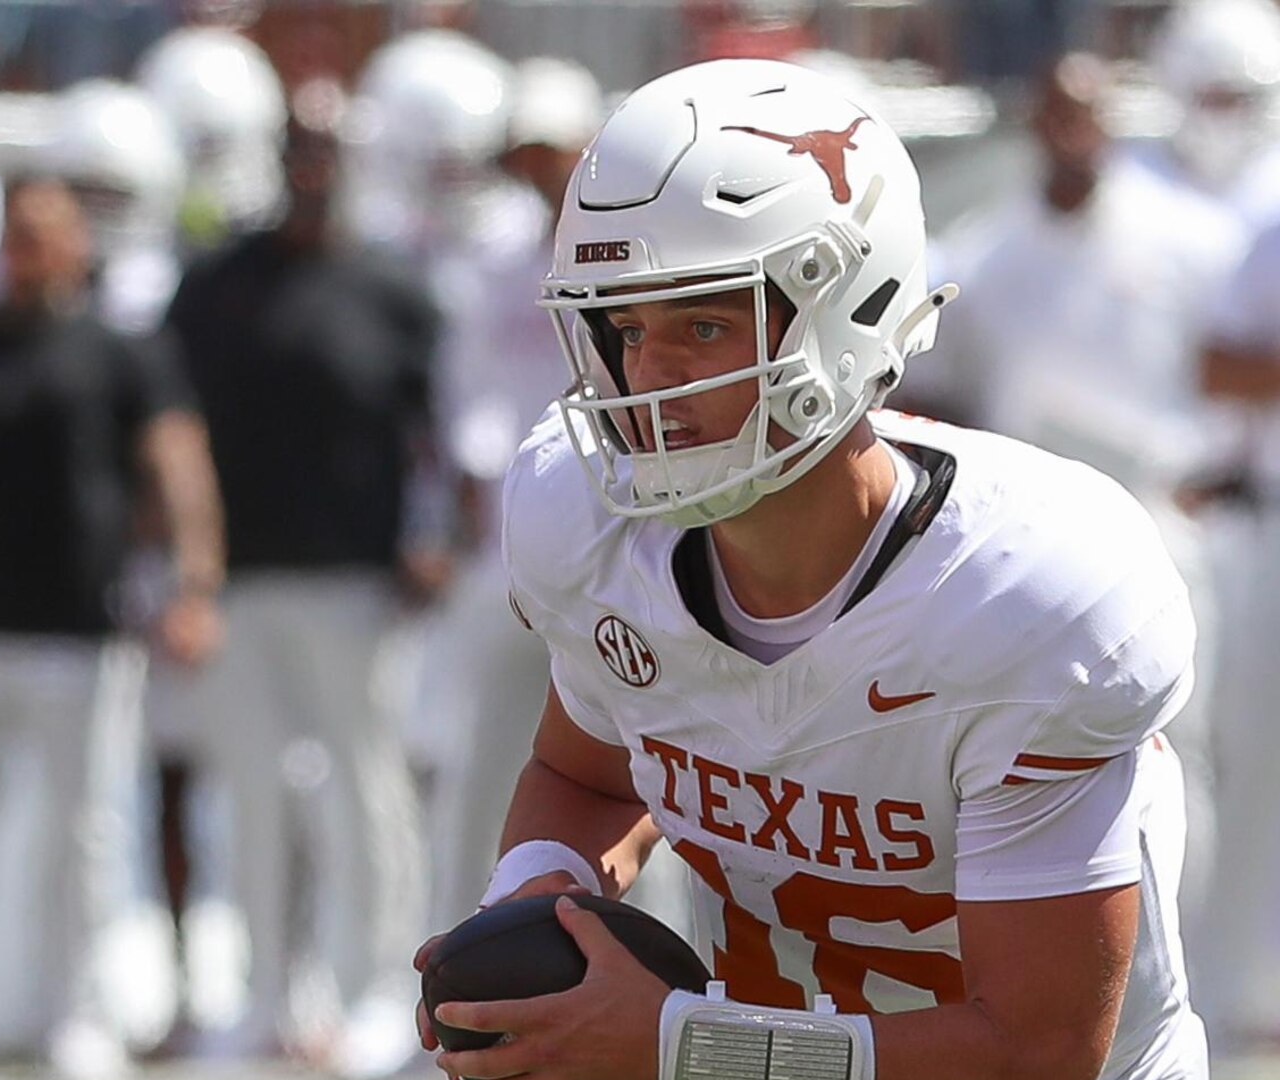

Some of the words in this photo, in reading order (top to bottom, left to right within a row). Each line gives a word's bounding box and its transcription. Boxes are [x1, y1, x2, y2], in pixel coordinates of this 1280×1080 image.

[574, 240, 631, 264] HORNS
[595, 615, 656, 687] SEC
[639, 734, 935, 872] TEXAS
[672, 838, 962, 1014] 16
